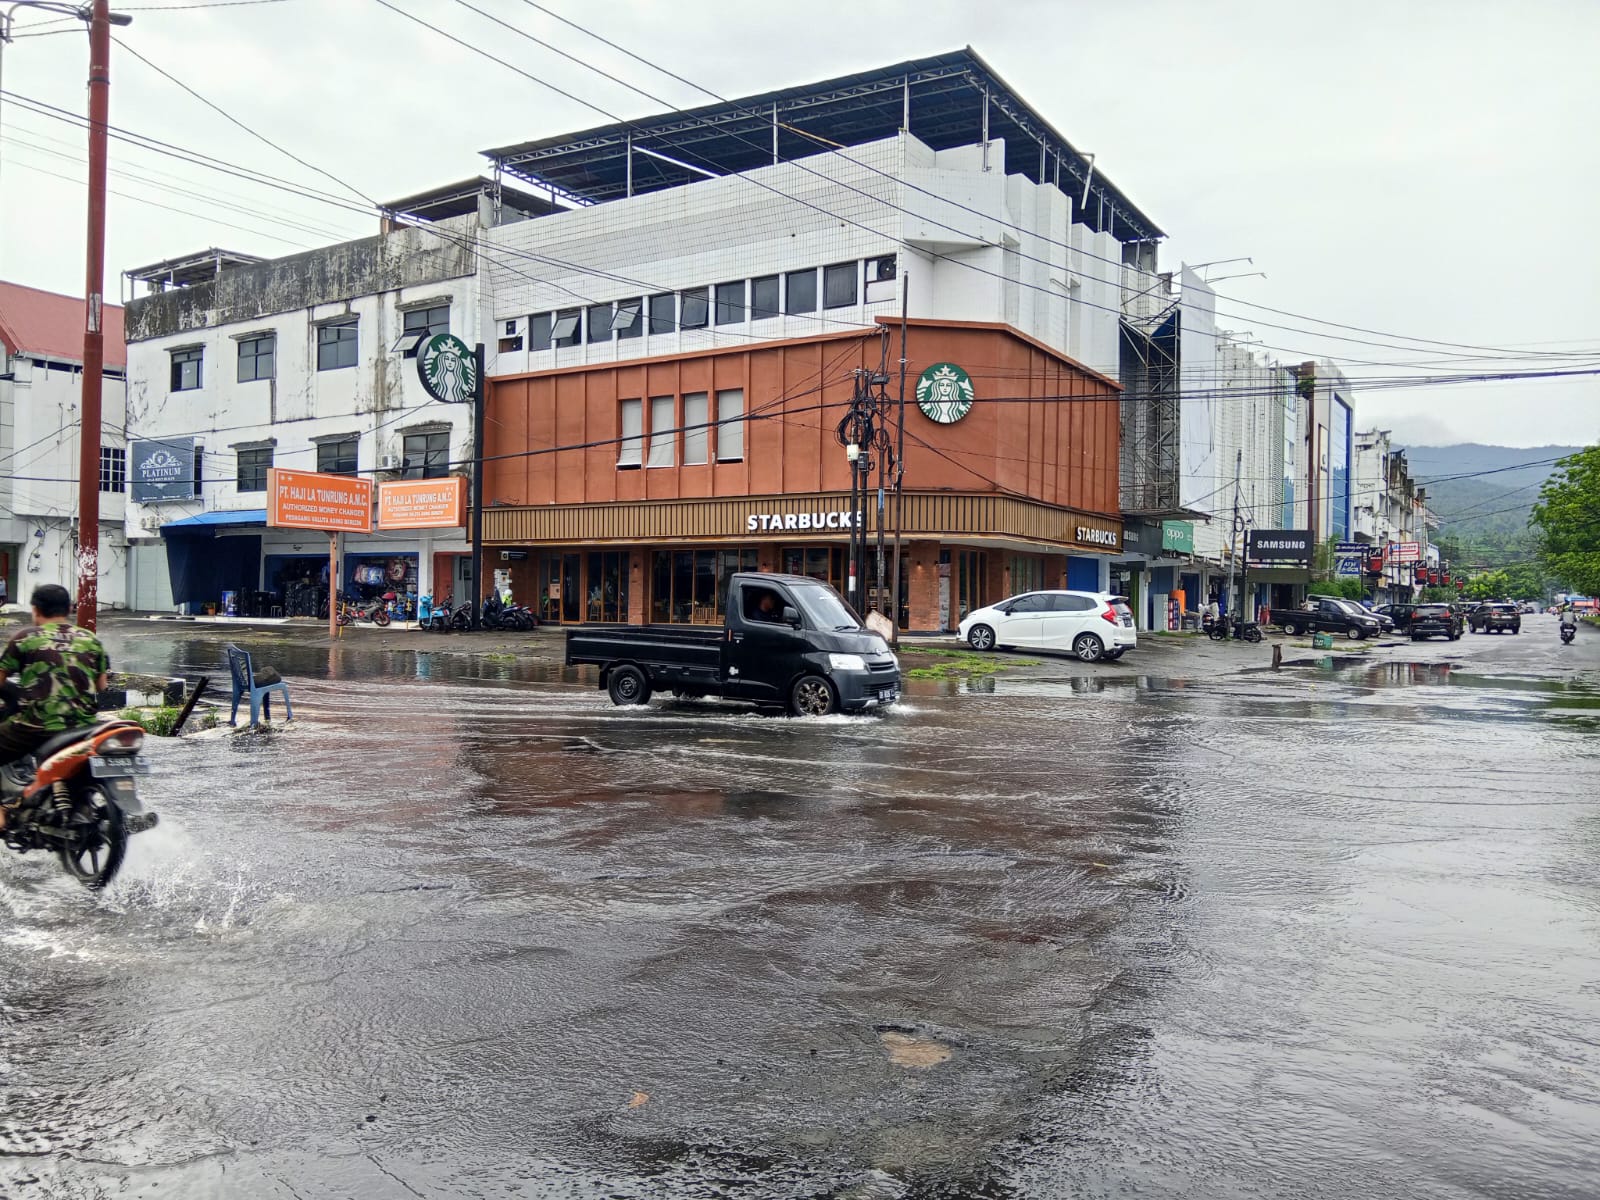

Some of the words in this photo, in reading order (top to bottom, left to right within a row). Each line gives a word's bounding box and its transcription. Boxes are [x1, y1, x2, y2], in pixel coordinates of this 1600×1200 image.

[142, 467, 181, 478] PLATINUM
[280, 485, 289, 499] PT.
[290, 486, 306, 501] HAJI
[308, 488, 316, 502] LA
[317, 489, 348, 505] TUNRUNG
[282, 503, 318, 513] AUTHORIZED
[319, 506, 338, 515] MONEY
[338, 508, 365, 517] CHANGER
[747, 511, 862, 530] STARBUCKS
[1077, 526, 1117, 546] STARBUCKS
[1257, 540, 1306, 550] SAMSUNG
